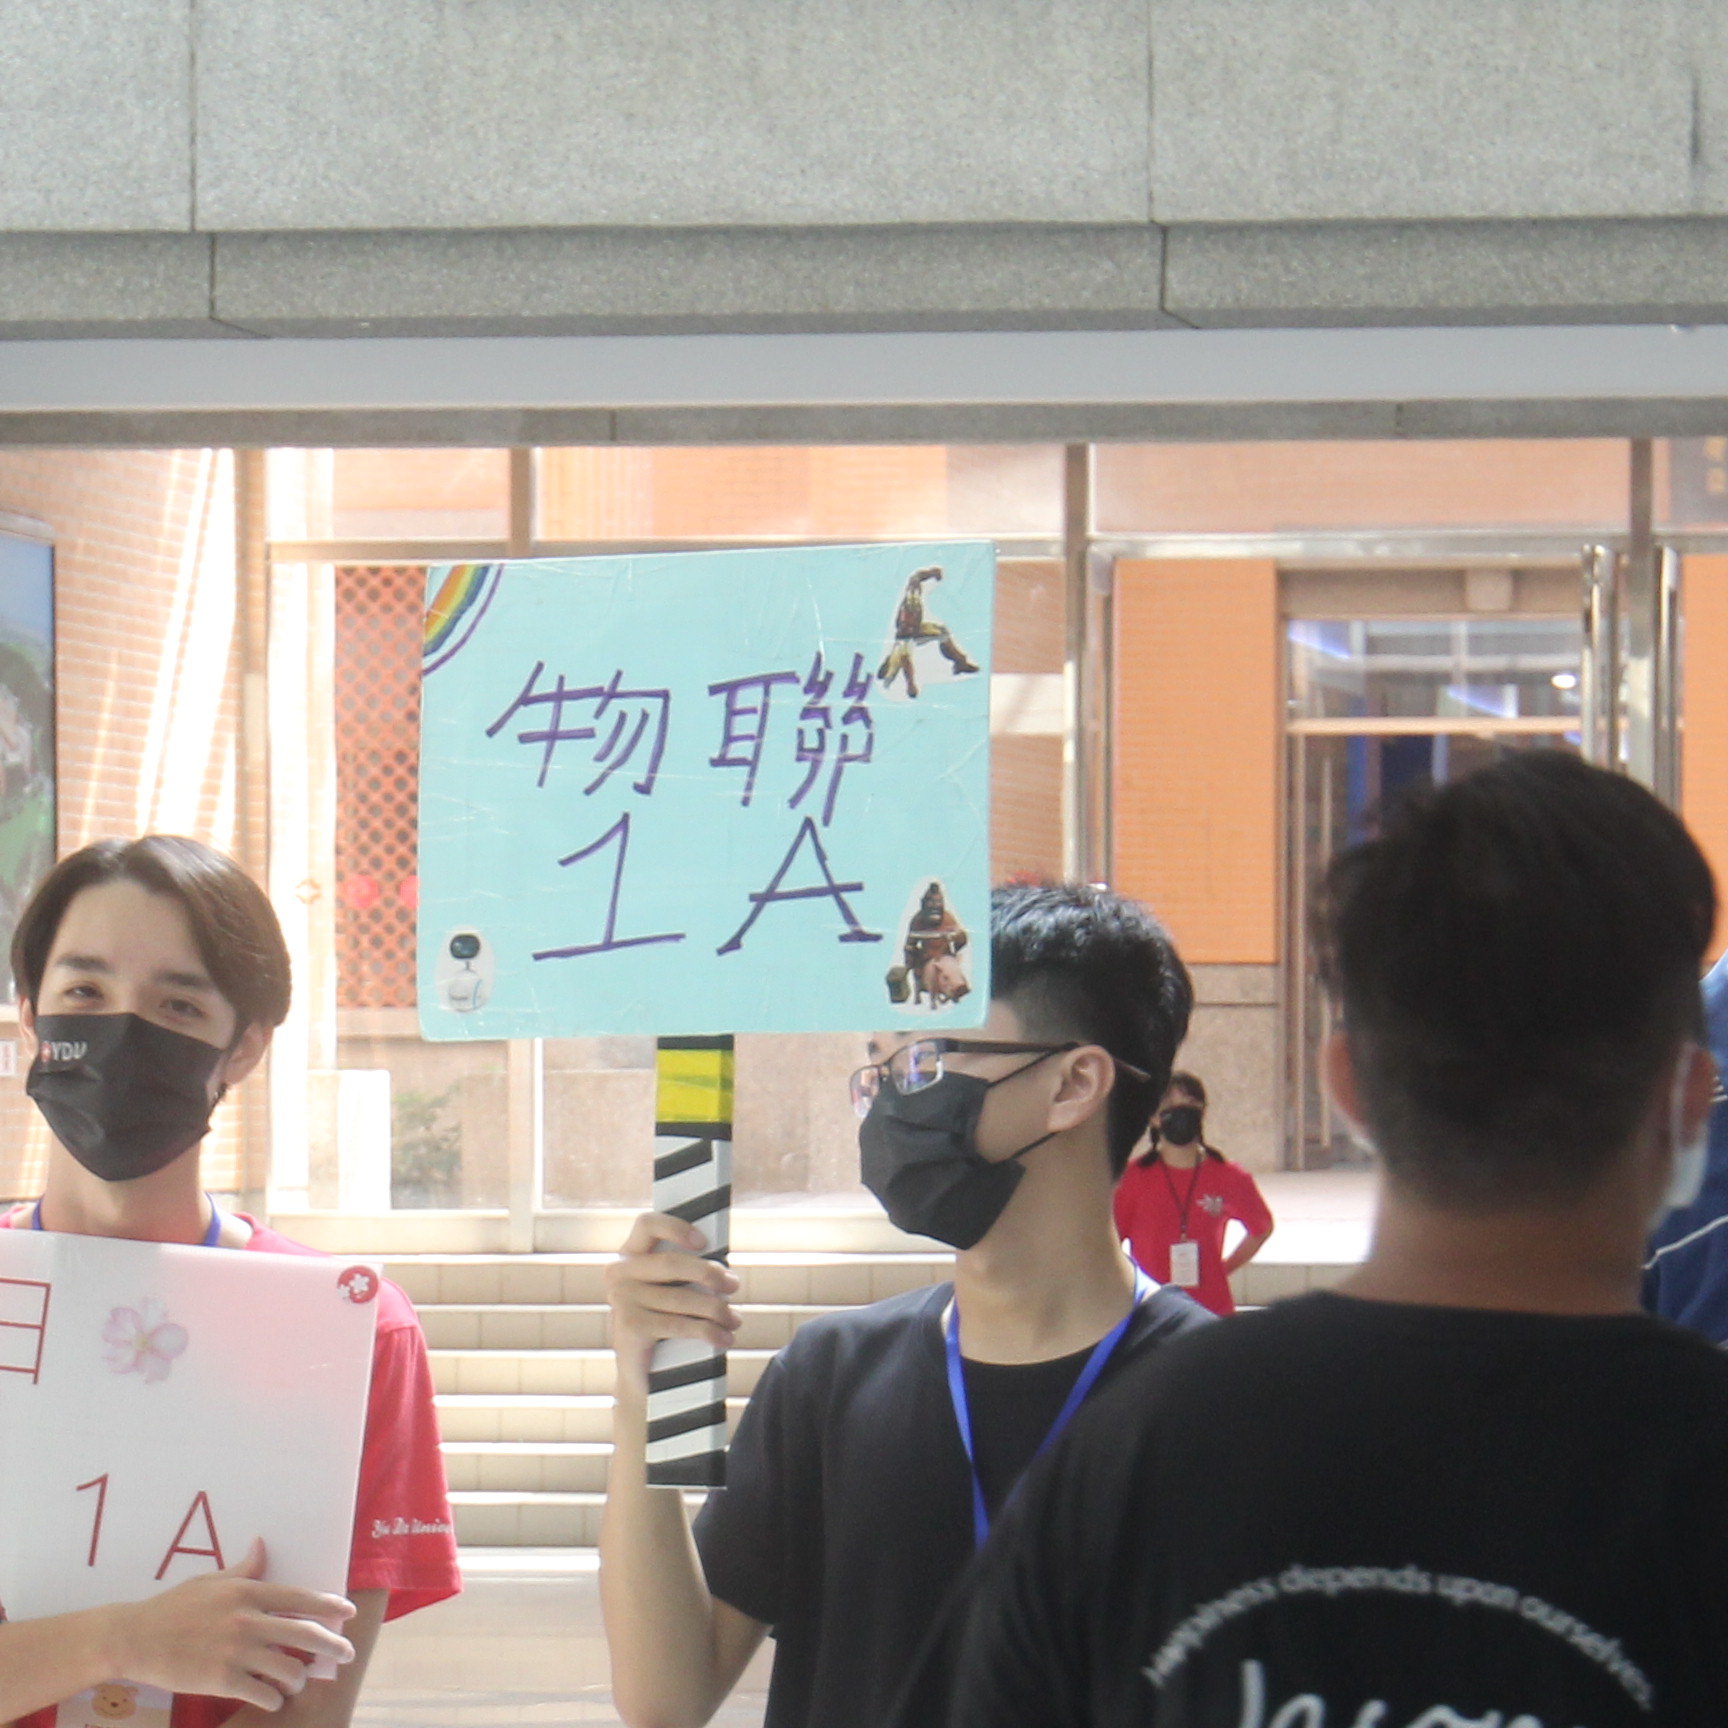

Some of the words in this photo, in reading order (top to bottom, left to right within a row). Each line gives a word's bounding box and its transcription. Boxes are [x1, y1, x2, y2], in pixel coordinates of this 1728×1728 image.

[485, 652, 875, 828] 物聯
[51, 1041, 88, 1061] YDU
[1277, 1562, 1433, 1599] depends
